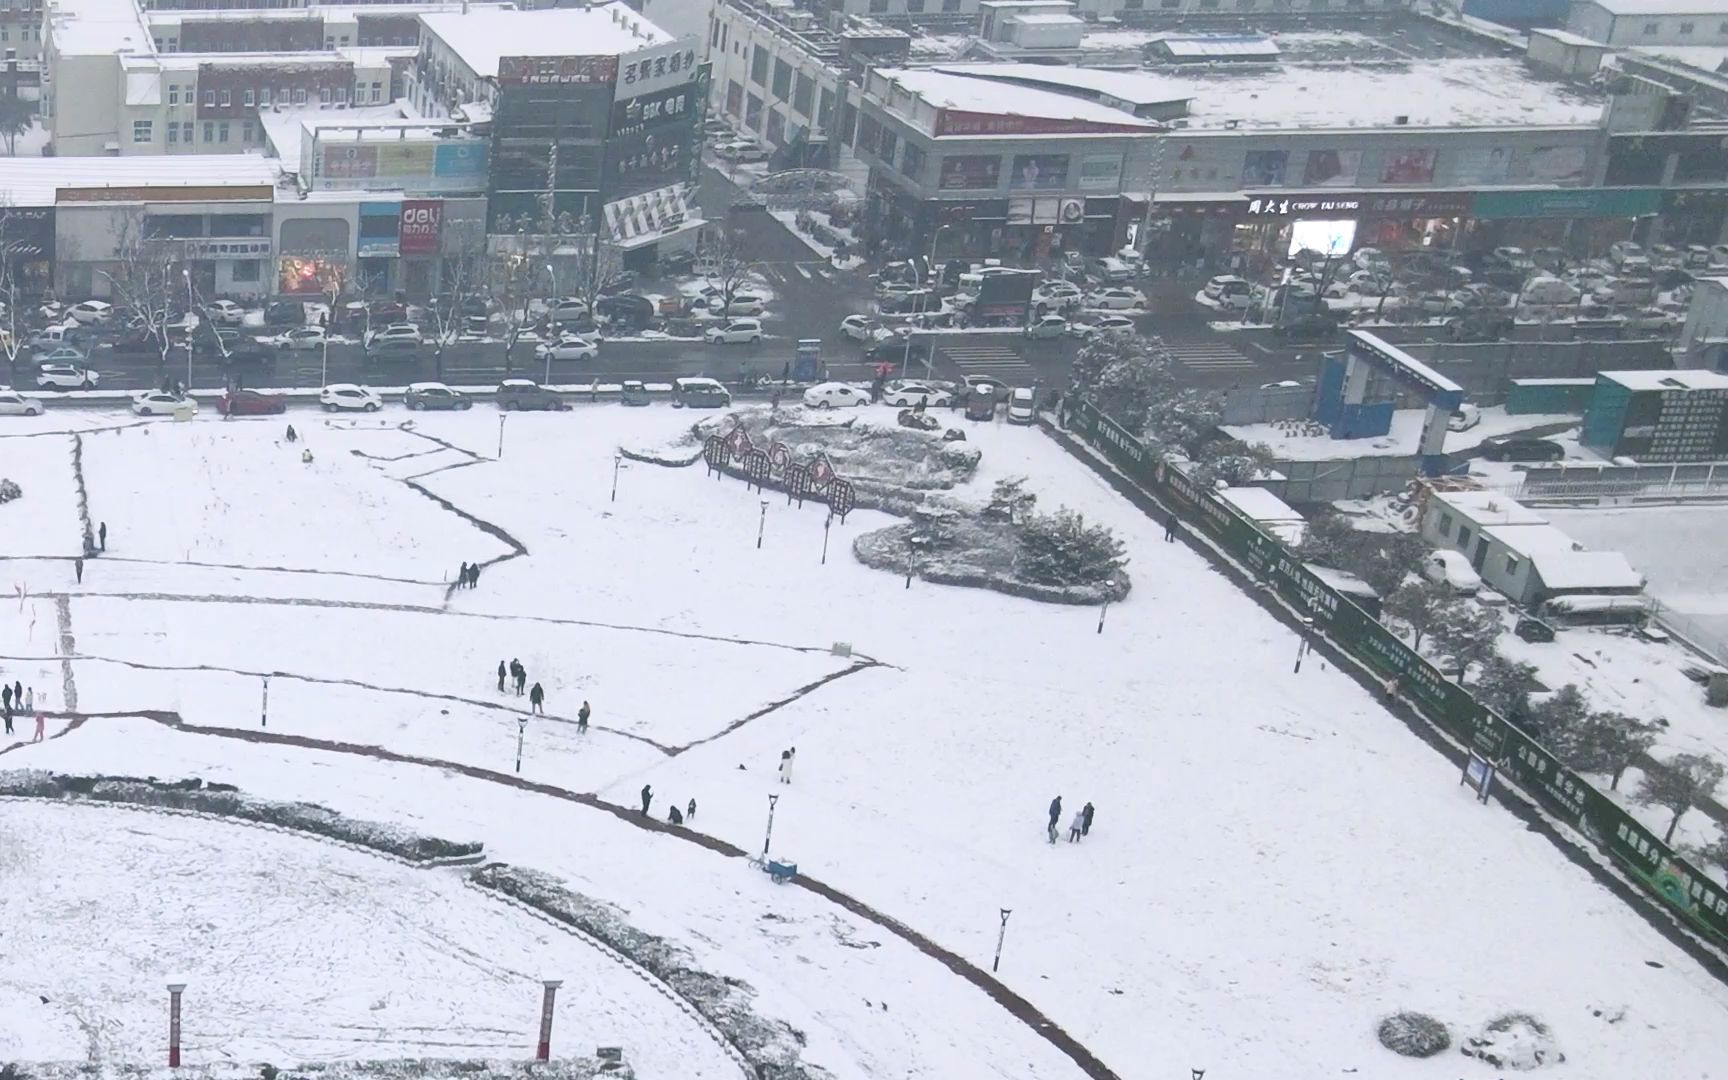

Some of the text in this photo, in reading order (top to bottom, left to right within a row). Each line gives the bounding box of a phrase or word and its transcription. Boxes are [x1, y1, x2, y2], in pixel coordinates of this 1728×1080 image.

[1248, 199, 1289, 214] 周大生
[404, 208, 440, 223] deli
